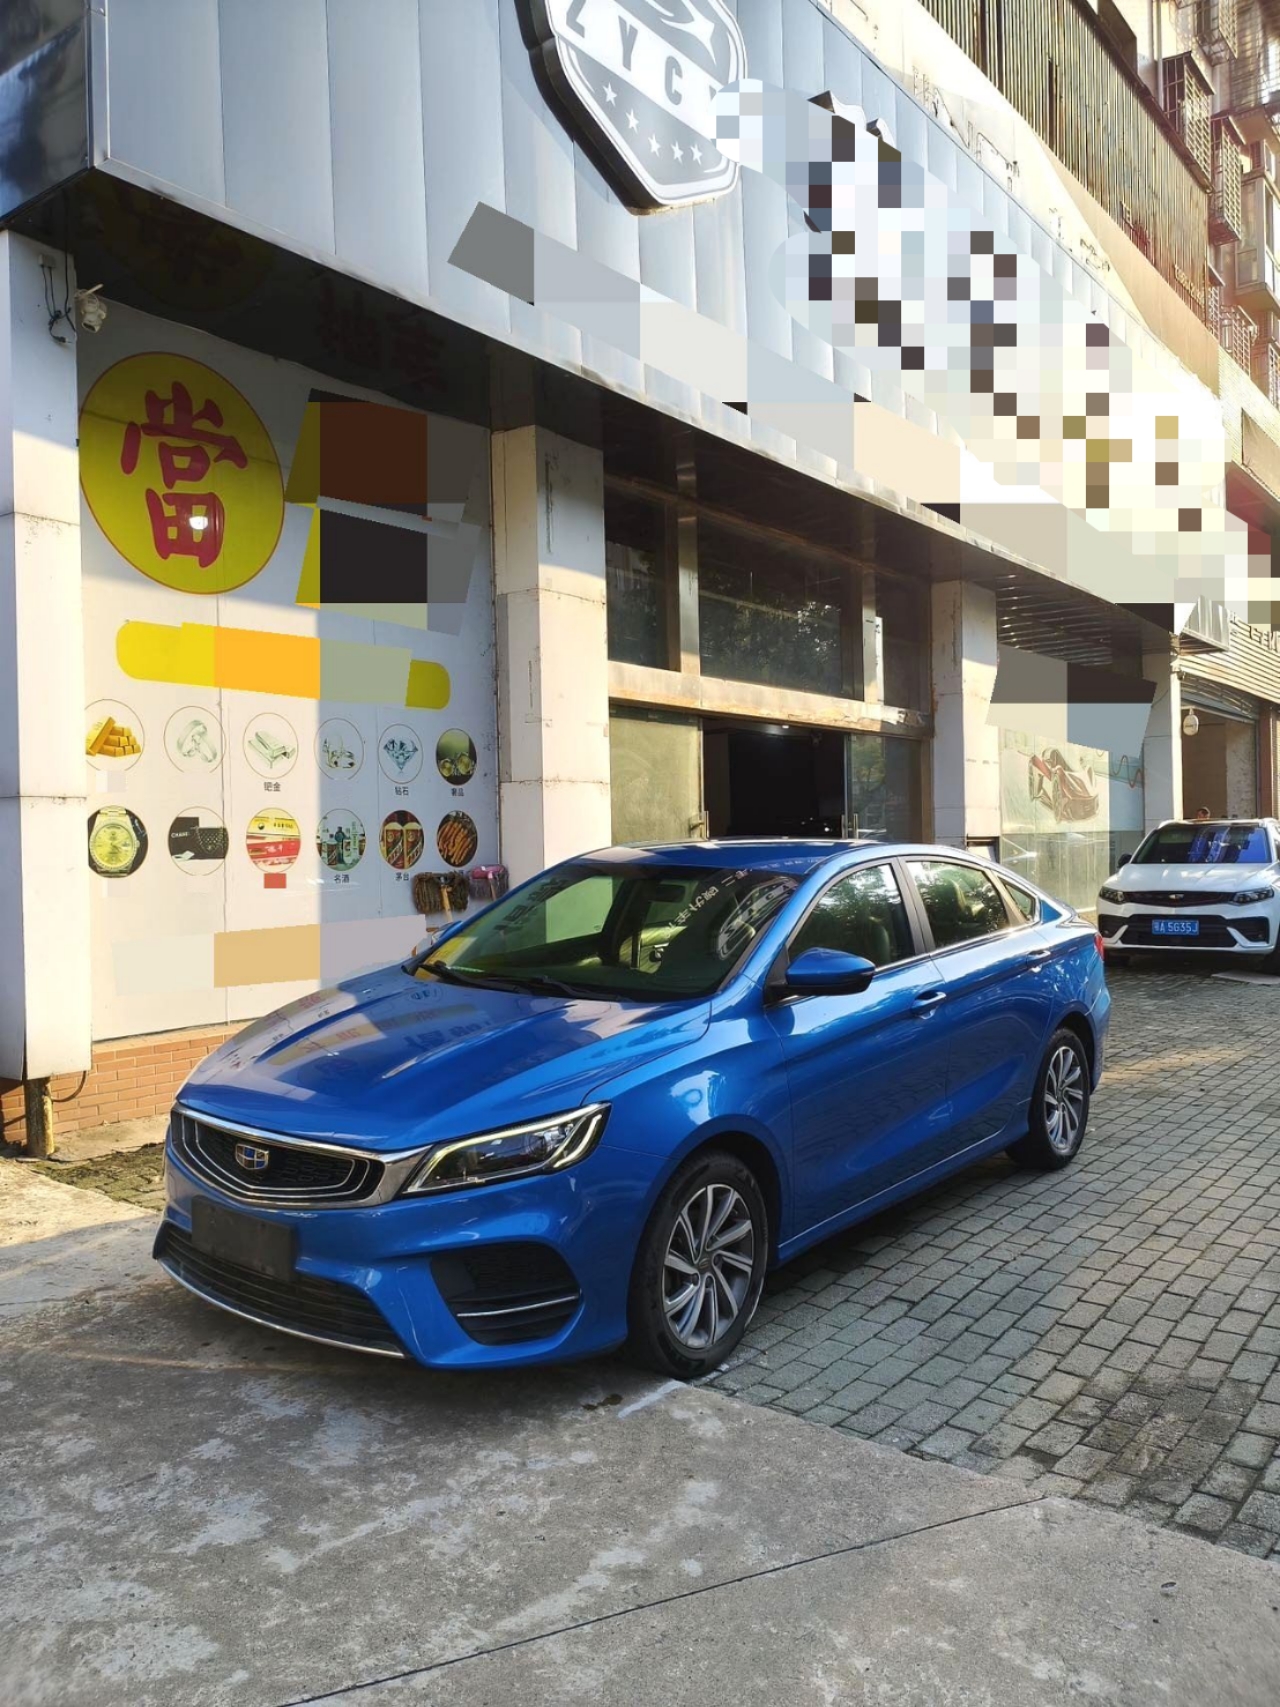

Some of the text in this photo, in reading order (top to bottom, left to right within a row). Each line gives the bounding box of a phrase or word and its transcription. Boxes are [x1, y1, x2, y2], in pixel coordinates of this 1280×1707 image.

[566, 0, 716, 105] ZYC
[121, 381, 248, 568] 當
[394, 786, 409, 796] 钻石
[334, 874, 350, 884] 名酒
[395, 872, 410, 881] 茅台
